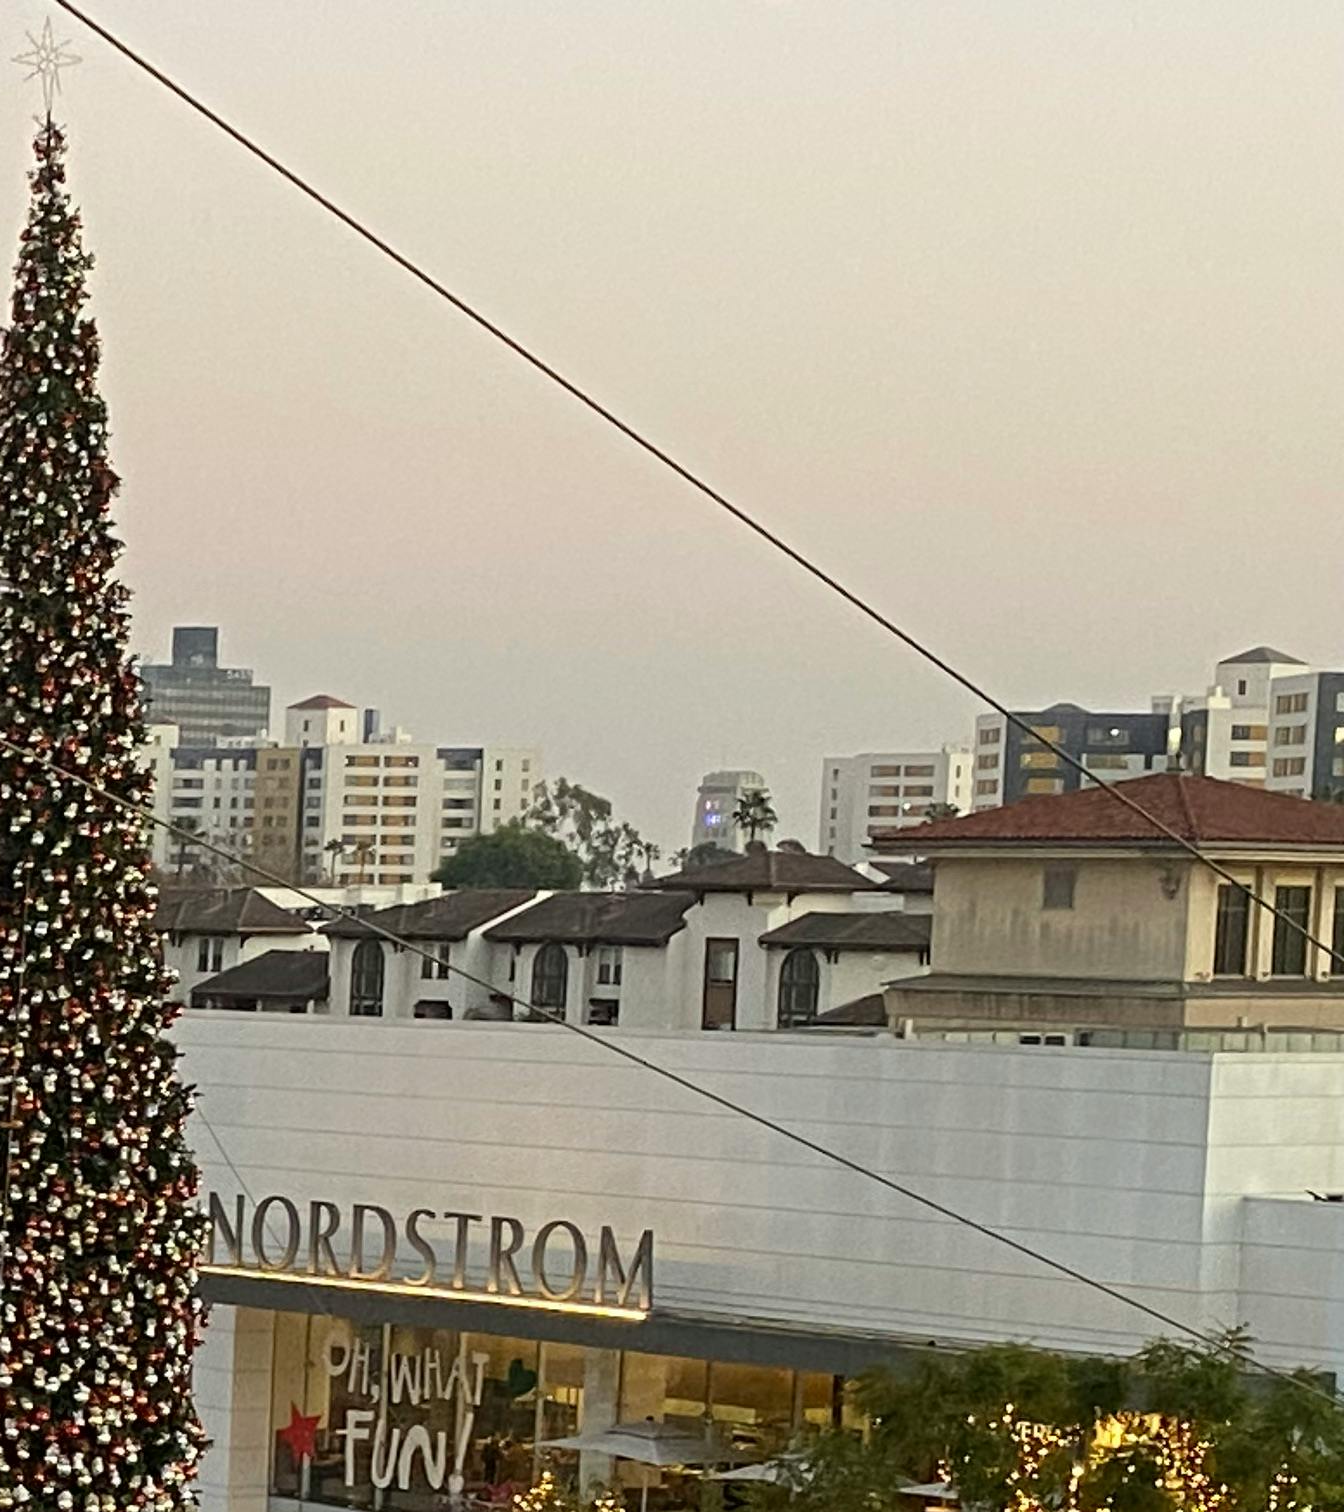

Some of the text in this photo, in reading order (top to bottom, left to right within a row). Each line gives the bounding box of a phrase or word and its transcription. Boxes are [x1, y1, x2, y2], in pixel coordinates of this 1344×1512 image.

[209, 1191, 652, 1309] NORDSTROM
[322, 1333, 490, 1406] OH, WHAT
[335, 1409, 474, 1493] FUN!
